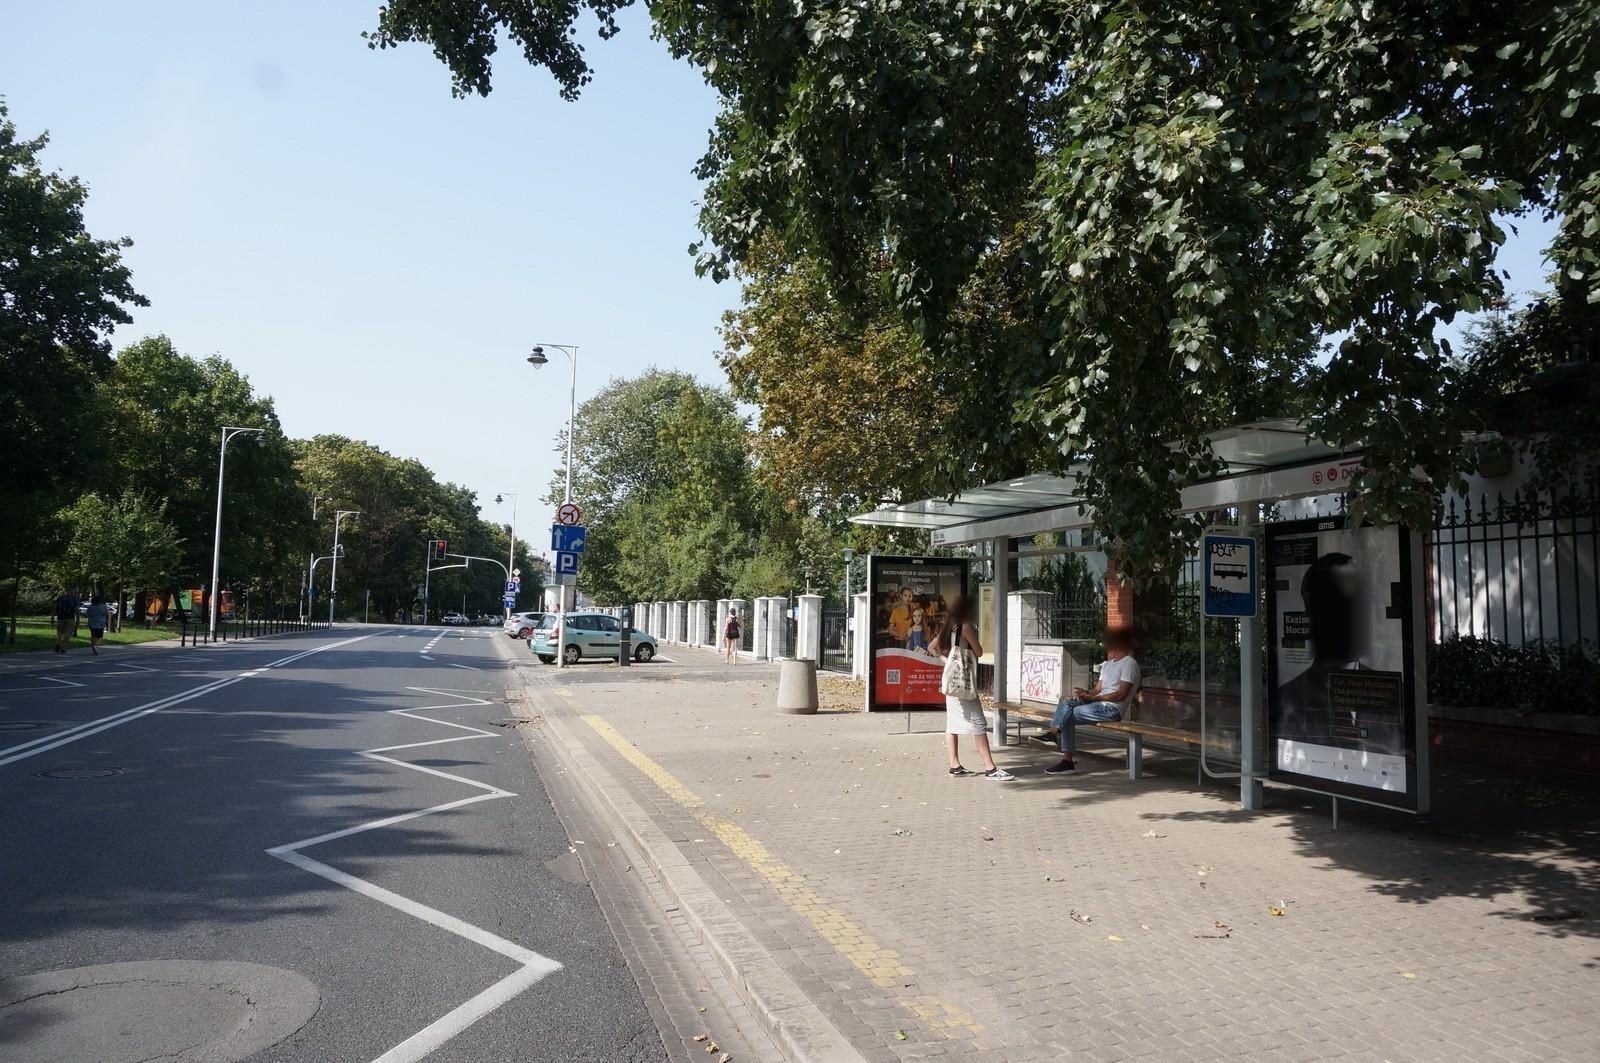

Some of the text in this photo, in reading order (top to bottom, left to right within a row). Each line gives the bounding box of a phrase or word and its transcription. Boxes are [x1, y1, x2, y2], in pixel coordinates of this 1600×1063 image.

[1318, 521, 1335, 530] ams
[560, 554, 574, 572] P
[507, 582, 514, 591] P
